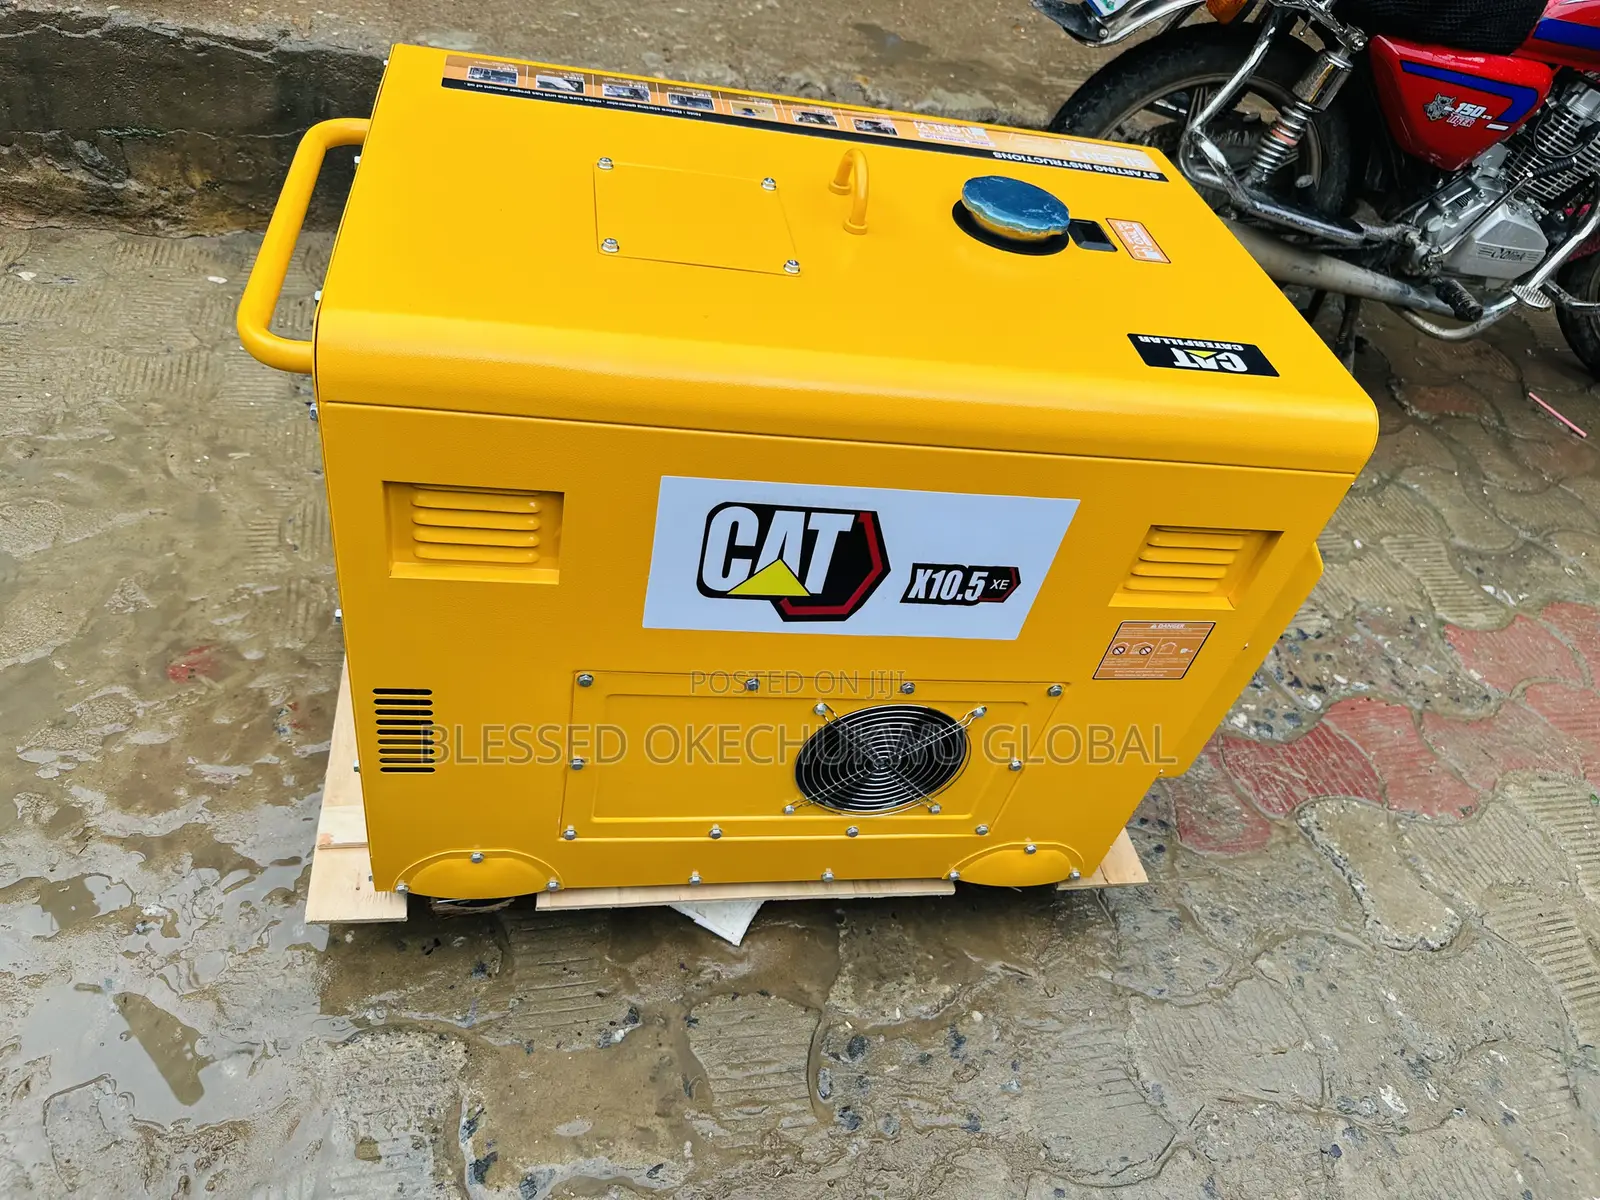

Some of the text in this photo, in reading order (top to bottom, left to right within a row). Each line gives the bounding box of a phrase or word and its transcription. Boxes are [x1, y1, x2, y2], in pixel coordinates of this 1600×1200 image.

[1455, 102, 1487, 118] 150
[992, 151, 1160, 180] STARTING INSTRUCTIONS
[1137, 335, 1244, 351] CATERPILLAR
[1170, 346, 1248, 372] CAT
[701, 505, 856, 595] CAT
[908, 568, 1010, 601] X10.5 XE
